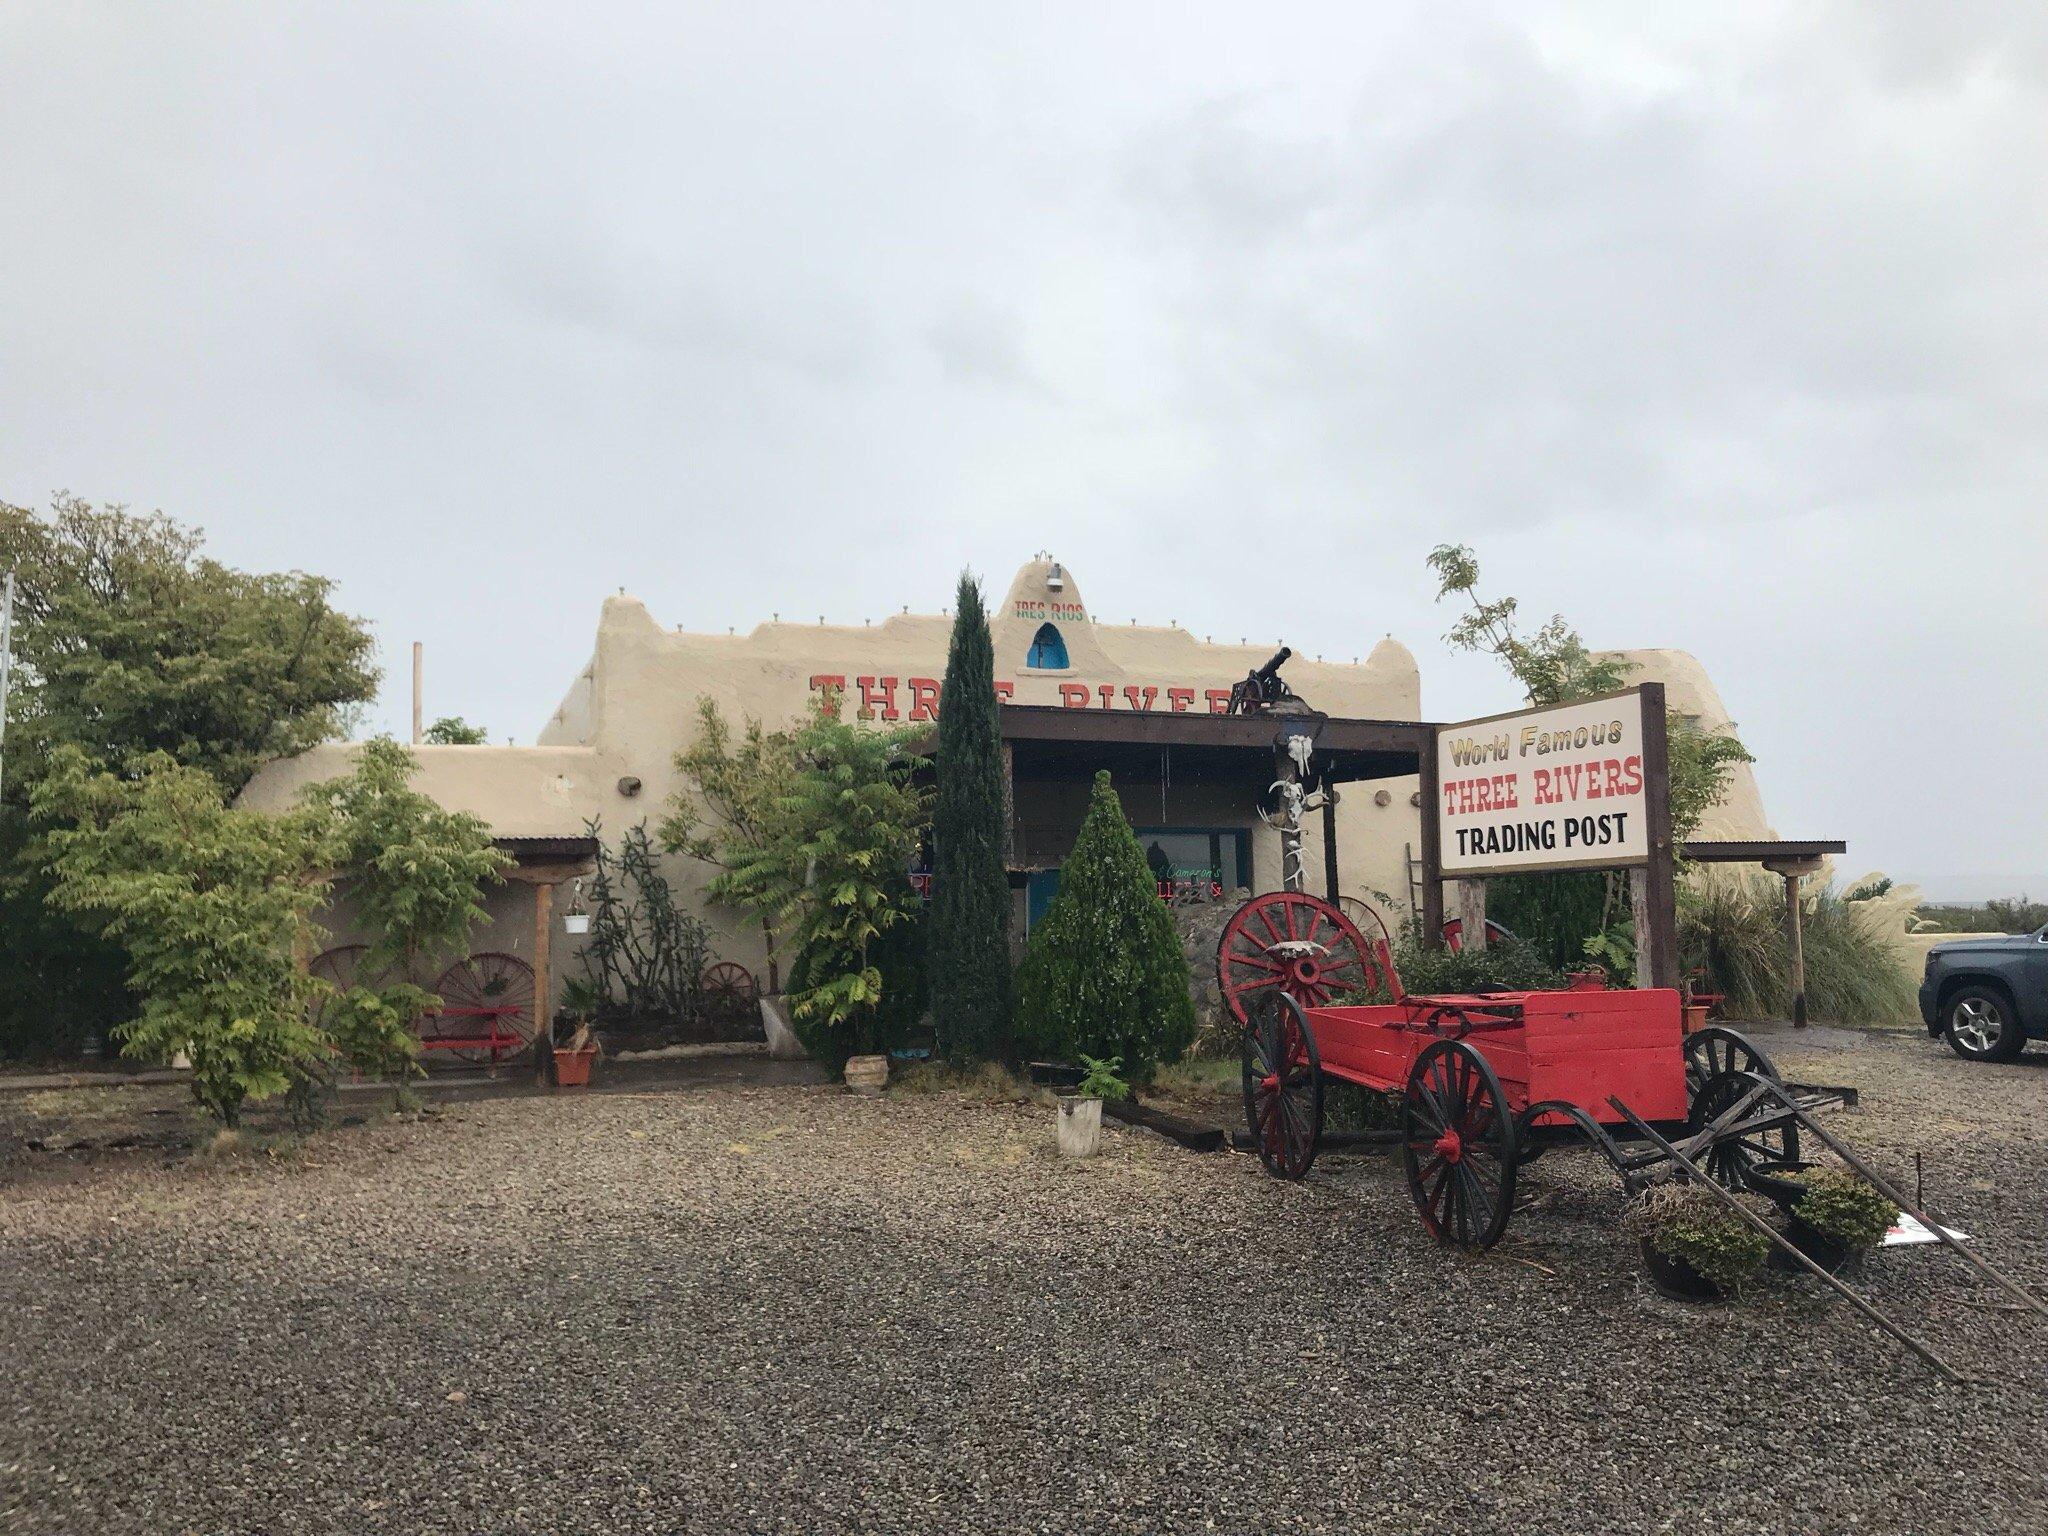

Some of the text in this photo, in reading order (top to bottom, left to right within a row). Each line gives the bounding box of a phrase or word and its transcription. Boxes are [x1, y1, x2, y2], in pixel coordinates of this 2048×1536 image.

[1015, 601, 1083, 621] TRES RIOS
[1449, 720, 1623, 767] World Famous
[1444, 755, 1644, 815] THREE RIVERS
[1456, 812, 1628, 856] TRADING POST
